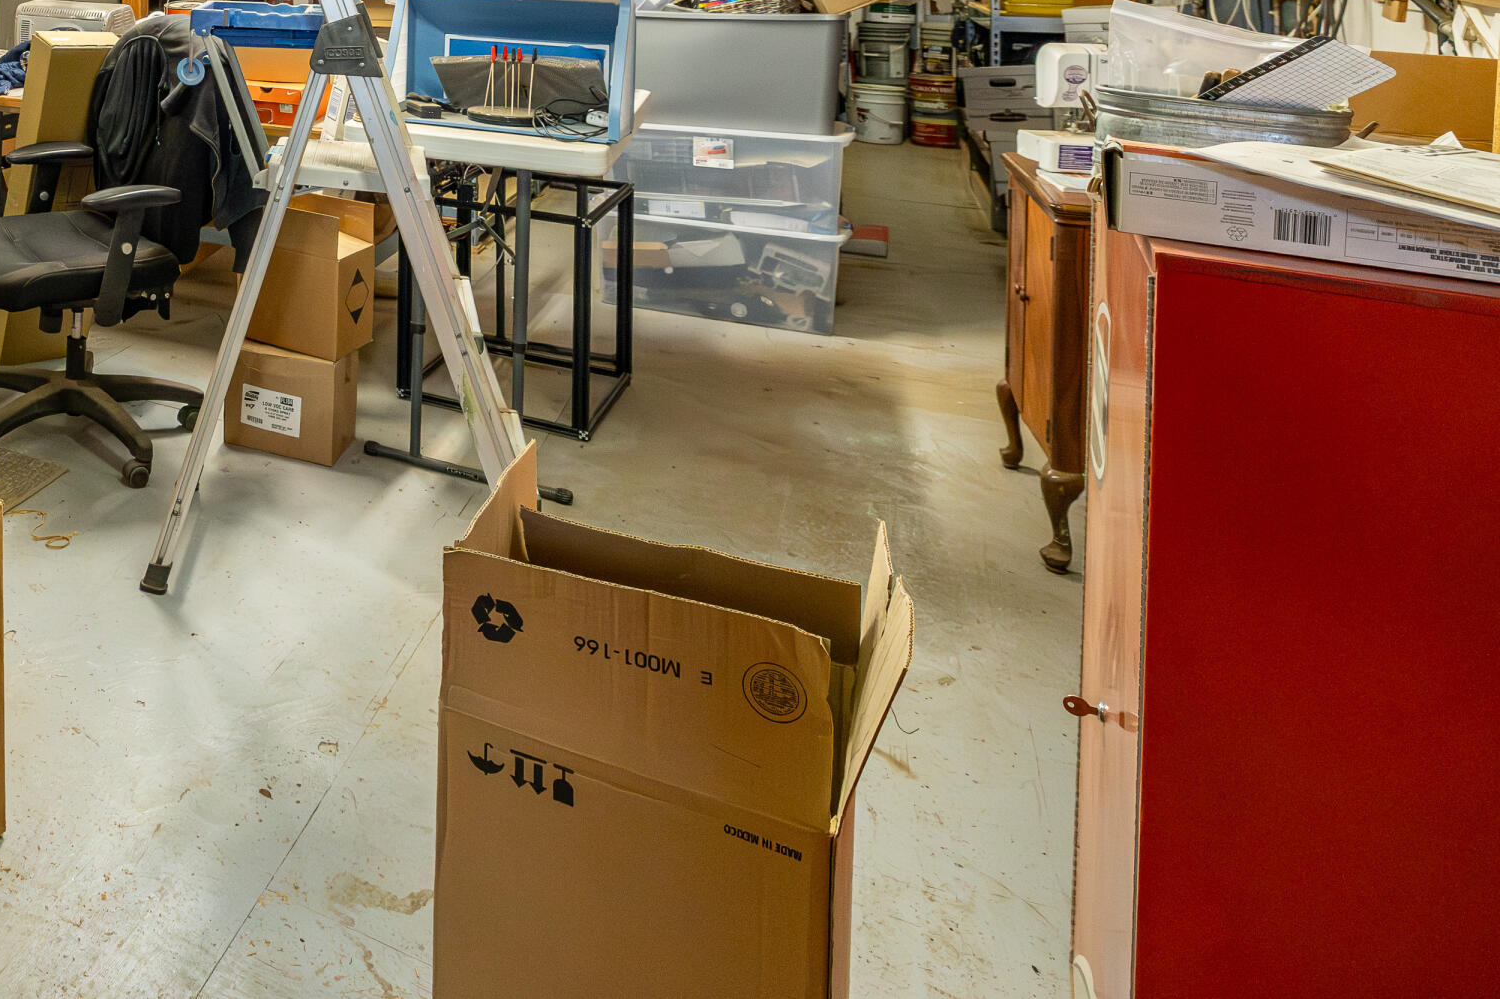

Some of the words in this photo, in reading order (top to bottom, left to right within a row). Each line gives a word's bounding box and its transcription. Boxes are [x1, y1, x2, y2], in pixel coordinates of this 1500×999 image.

[700, 670, 713, 686] E
[723, 824, 759, 845] MEXICO
[762, 836, 773, 851] IN
[775, 842, 802, 862] MADE
